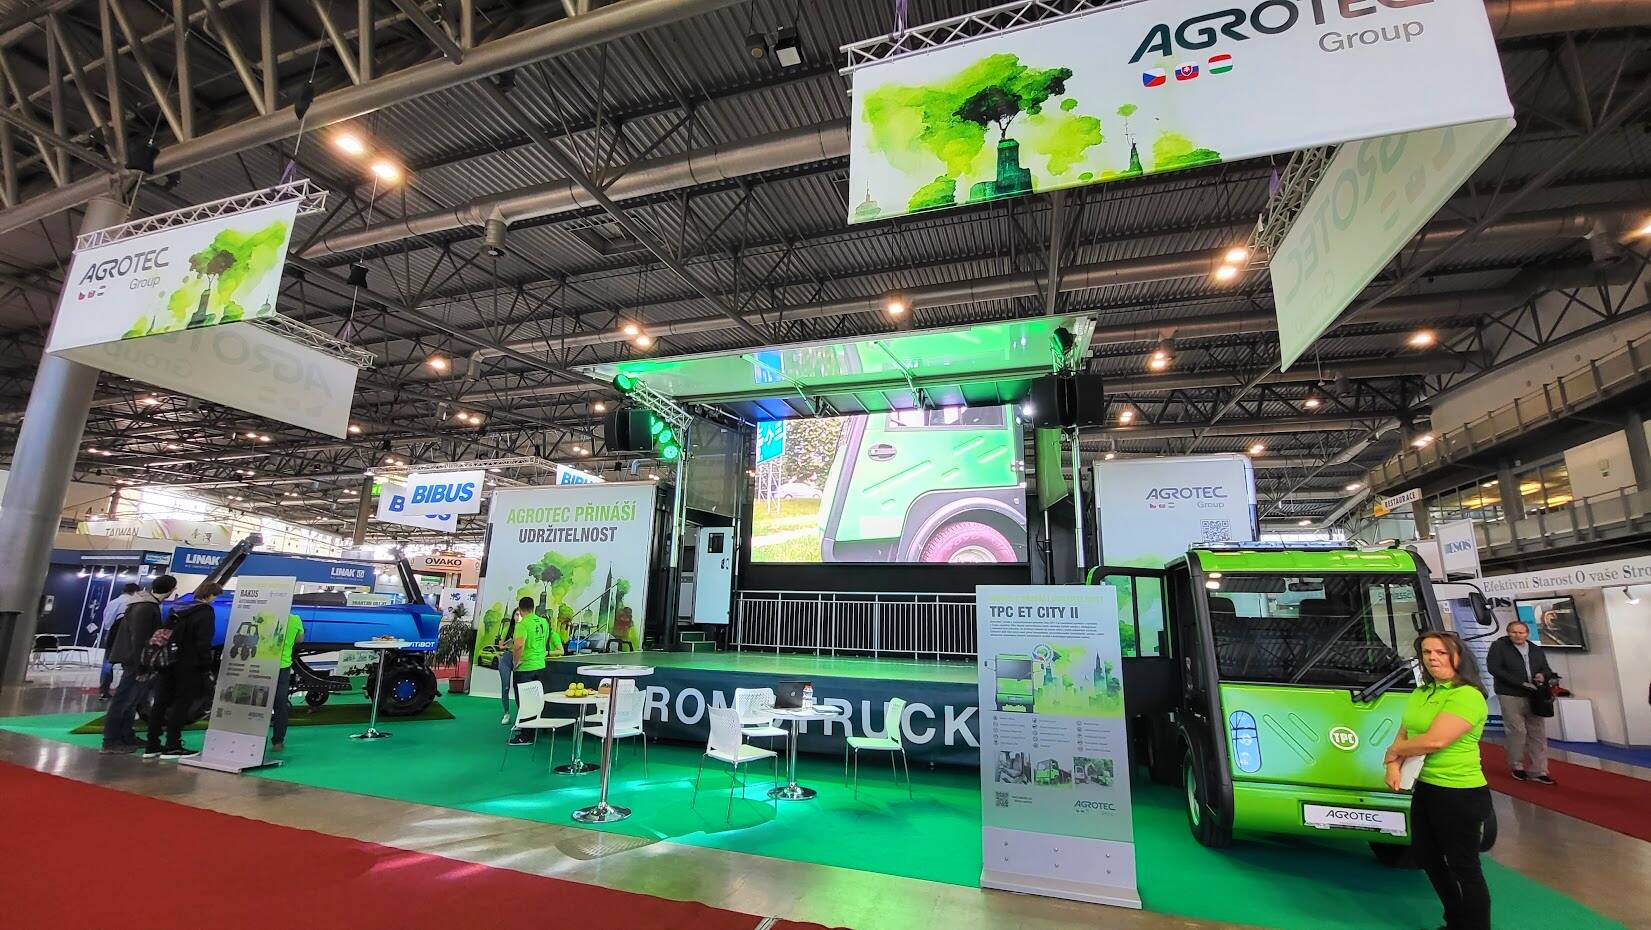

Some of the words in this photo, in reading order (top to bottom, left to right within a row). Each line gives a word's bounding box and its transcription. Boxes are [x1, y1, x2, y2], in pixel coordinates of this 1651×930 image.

[1128, 0, 1434, 65] AGROTE
[1318, 20, 1424, 53] Group
[78, 246, 170, 286] AGROTEC
[129, 276, 161, 290] Group
[411, 482, 475, 504] BIBUS
[1146, 486, 1228, 500] AGROTEC
[1384, 491, 1416, 508] RESTAURACE
[506, 505, 571, 525] AGROTEC
[574, 499, 637, 523] PŘINÁŠÍ
[105, 527, 140, 537] TAIWAN
[518, 524, 618, 544] UDRŽITELNOST
[185, 553, 221, 566] LINAK
[425, 557, 462, 566] OVAKO
[331, 567, 356, 578] LINAK
[1532, 574, 1573, 589] Starost
[1575, 570, 1585, 584] O
[1588, 568, 1619, 582] vaše
[990, 605, 1014, 618] TPC
[1018, 606, 1033, 618] ET
[1037, 606, 1066, 619] CITY
[1332, 732, 1355, 744] TPC
[1074, 799, 1116, 811] AGROTEC
[1325, 809, 1383, 823] AGROTEC
